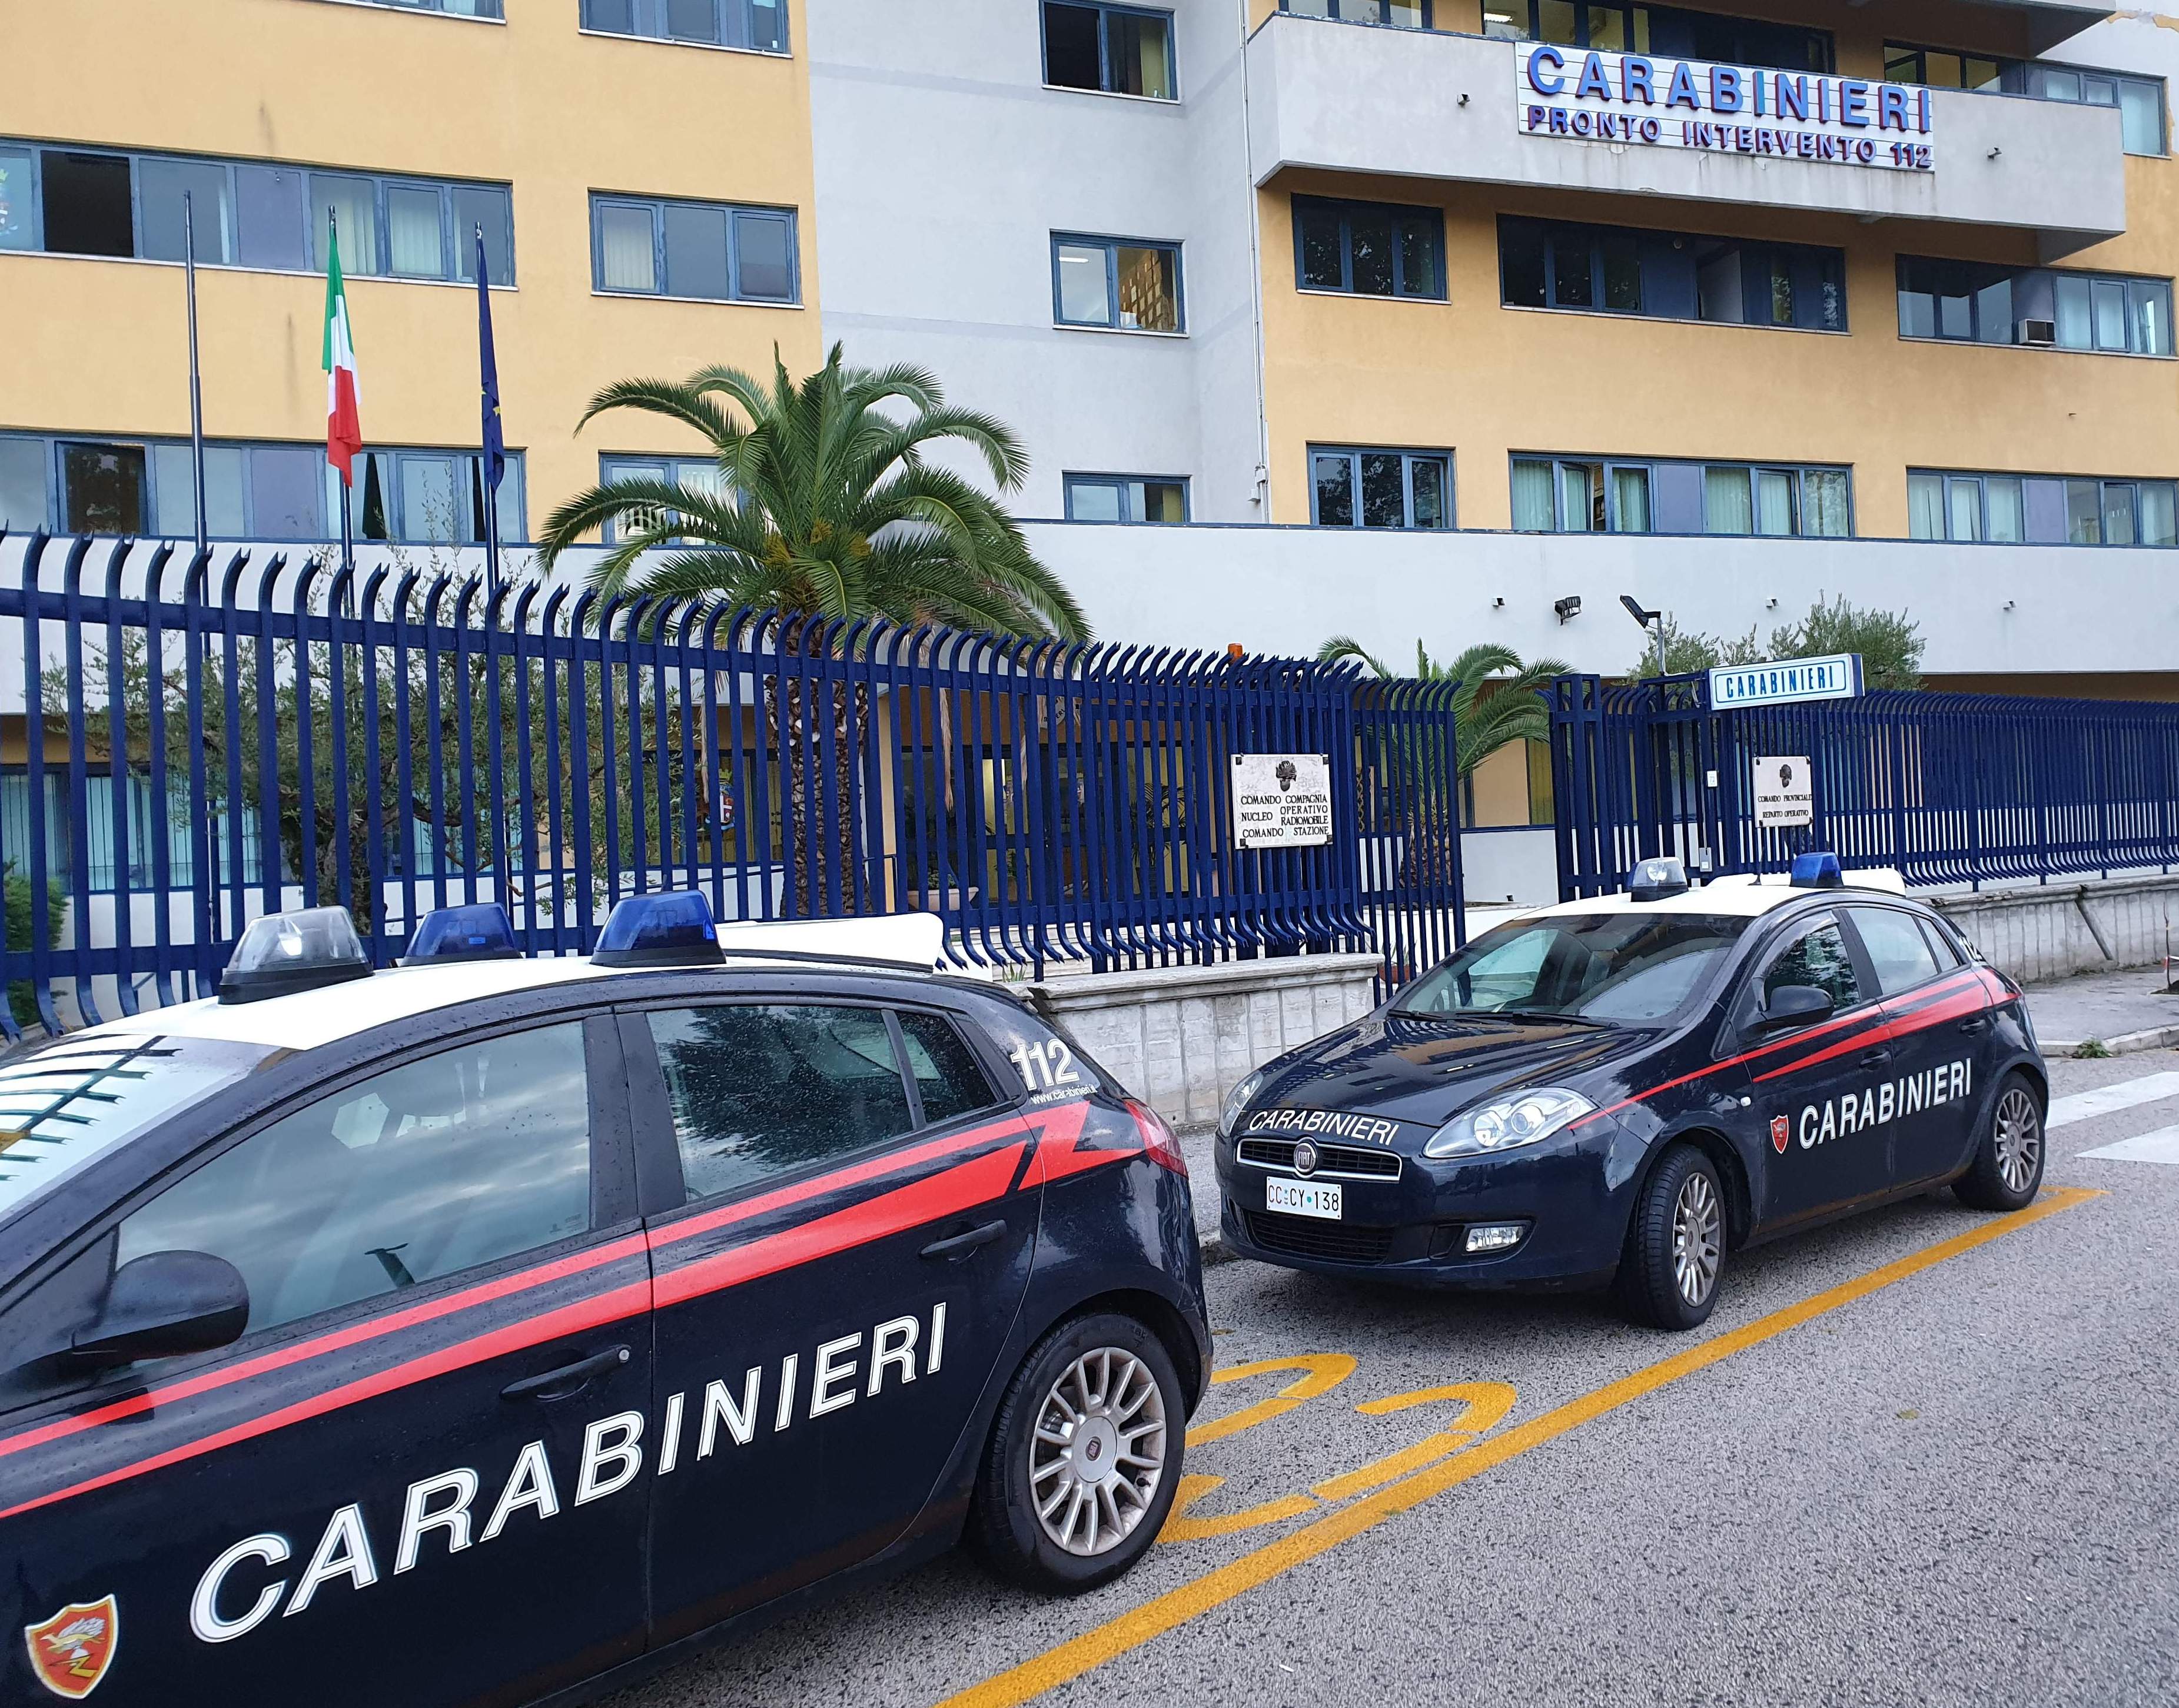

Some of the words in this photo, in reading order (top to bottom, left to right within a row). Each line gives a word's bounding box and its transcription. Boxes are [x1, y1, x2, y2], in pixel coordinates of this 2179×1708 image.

[1526, 45, 1932, 134] CARABINIERI
[1527, 105, 1662, 143] PRONTO
[1683, 121, 1876, 163] INTERVENTO
[1890, 142, 1932, 168] 112
[1726, 665, 1833, 698] CARABINIERI
[1241, 795, 1281, 805] COMANDO
[1285, 794, 1328, 804] COMPAGNIA
[1783, 793, 1812, 802] PROVINCIALE
[1241, 812, 1273, 822] NUCLEO
[1280, 805, 1328, 815] OPERATIVO
[1784, 809, 1809, 818] OPERATIVO
[1281, 815, 1328, 826] RADIOMOBILE
[1243, 828, 1284, 838] COMANDO
[1293, 826, 1329, 836] STAZIONE
[1010, 1038, 1080, 1091] 112
[1030, 1084, 1098, 1105] www.carabinieri.it
[1799, 1058, 1971, 1150] CARABINIERI
[1249, 1109, 1400, 1145] CARABINIERI
[1298, 1151, 1311, 1165] FIAT
[189, 1301, 947, 1644] CARABINIERI
